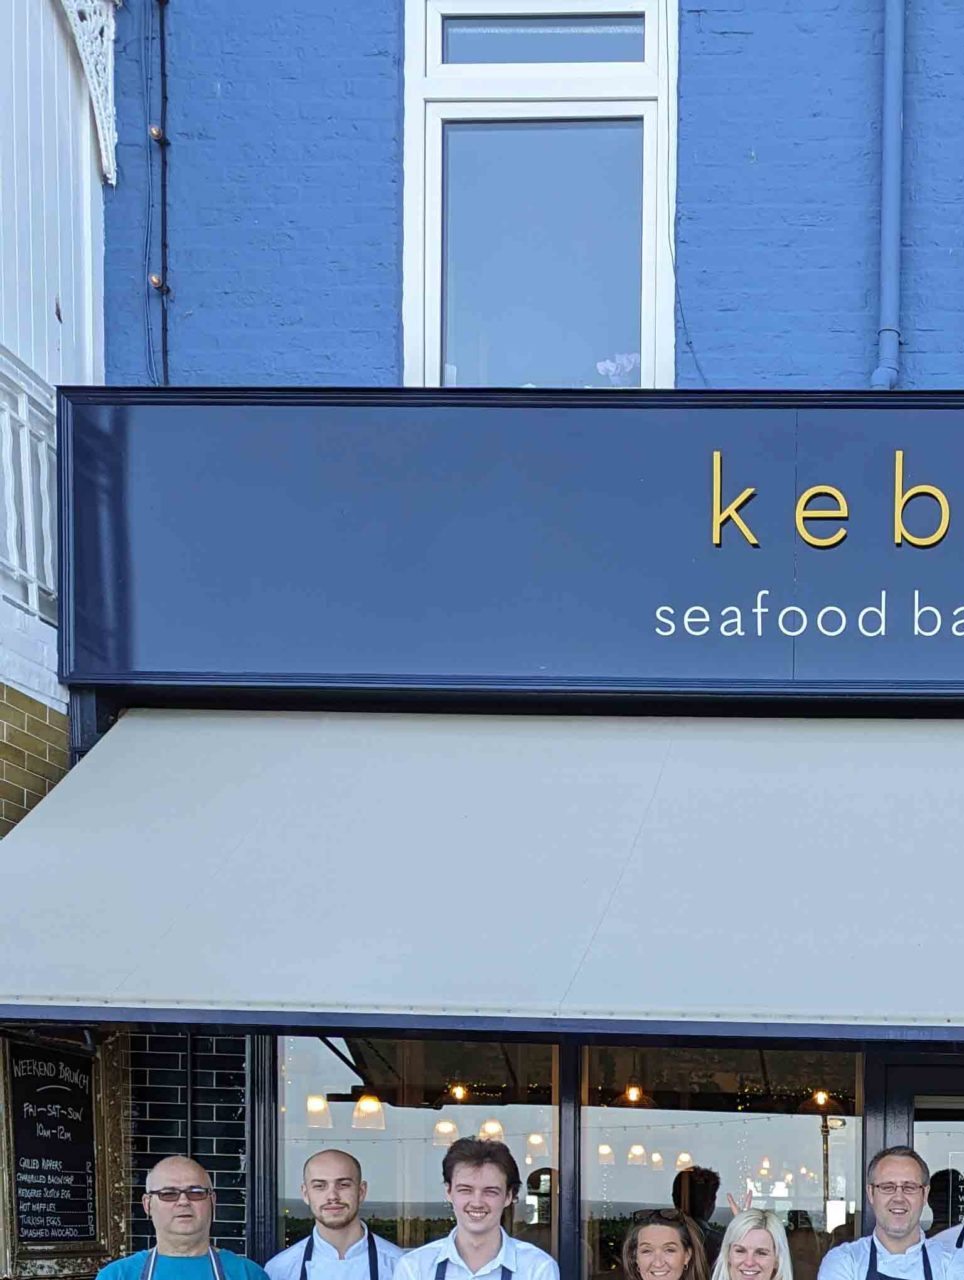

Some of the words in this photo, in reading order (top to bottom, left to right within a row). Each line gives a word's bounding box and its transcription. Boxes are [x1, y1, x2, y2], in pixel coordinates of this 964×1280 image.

[655, 590, 887, 637] seafood
[13, 1058, 56, 1077] WEEKEND
[58, 1062, 89, 1094] BRUNCH
[19, 1200, 31, 1212] HOT
[31, 1202, 56, 1213] WAFFLES
[19, 1214, 45, 1227] TURKISH
[46, 1216, 62, 1227] EGGS
[19, 1227, 49, 1238] SMASHED
[51, 1227, 79, 1239] AVOCADO
